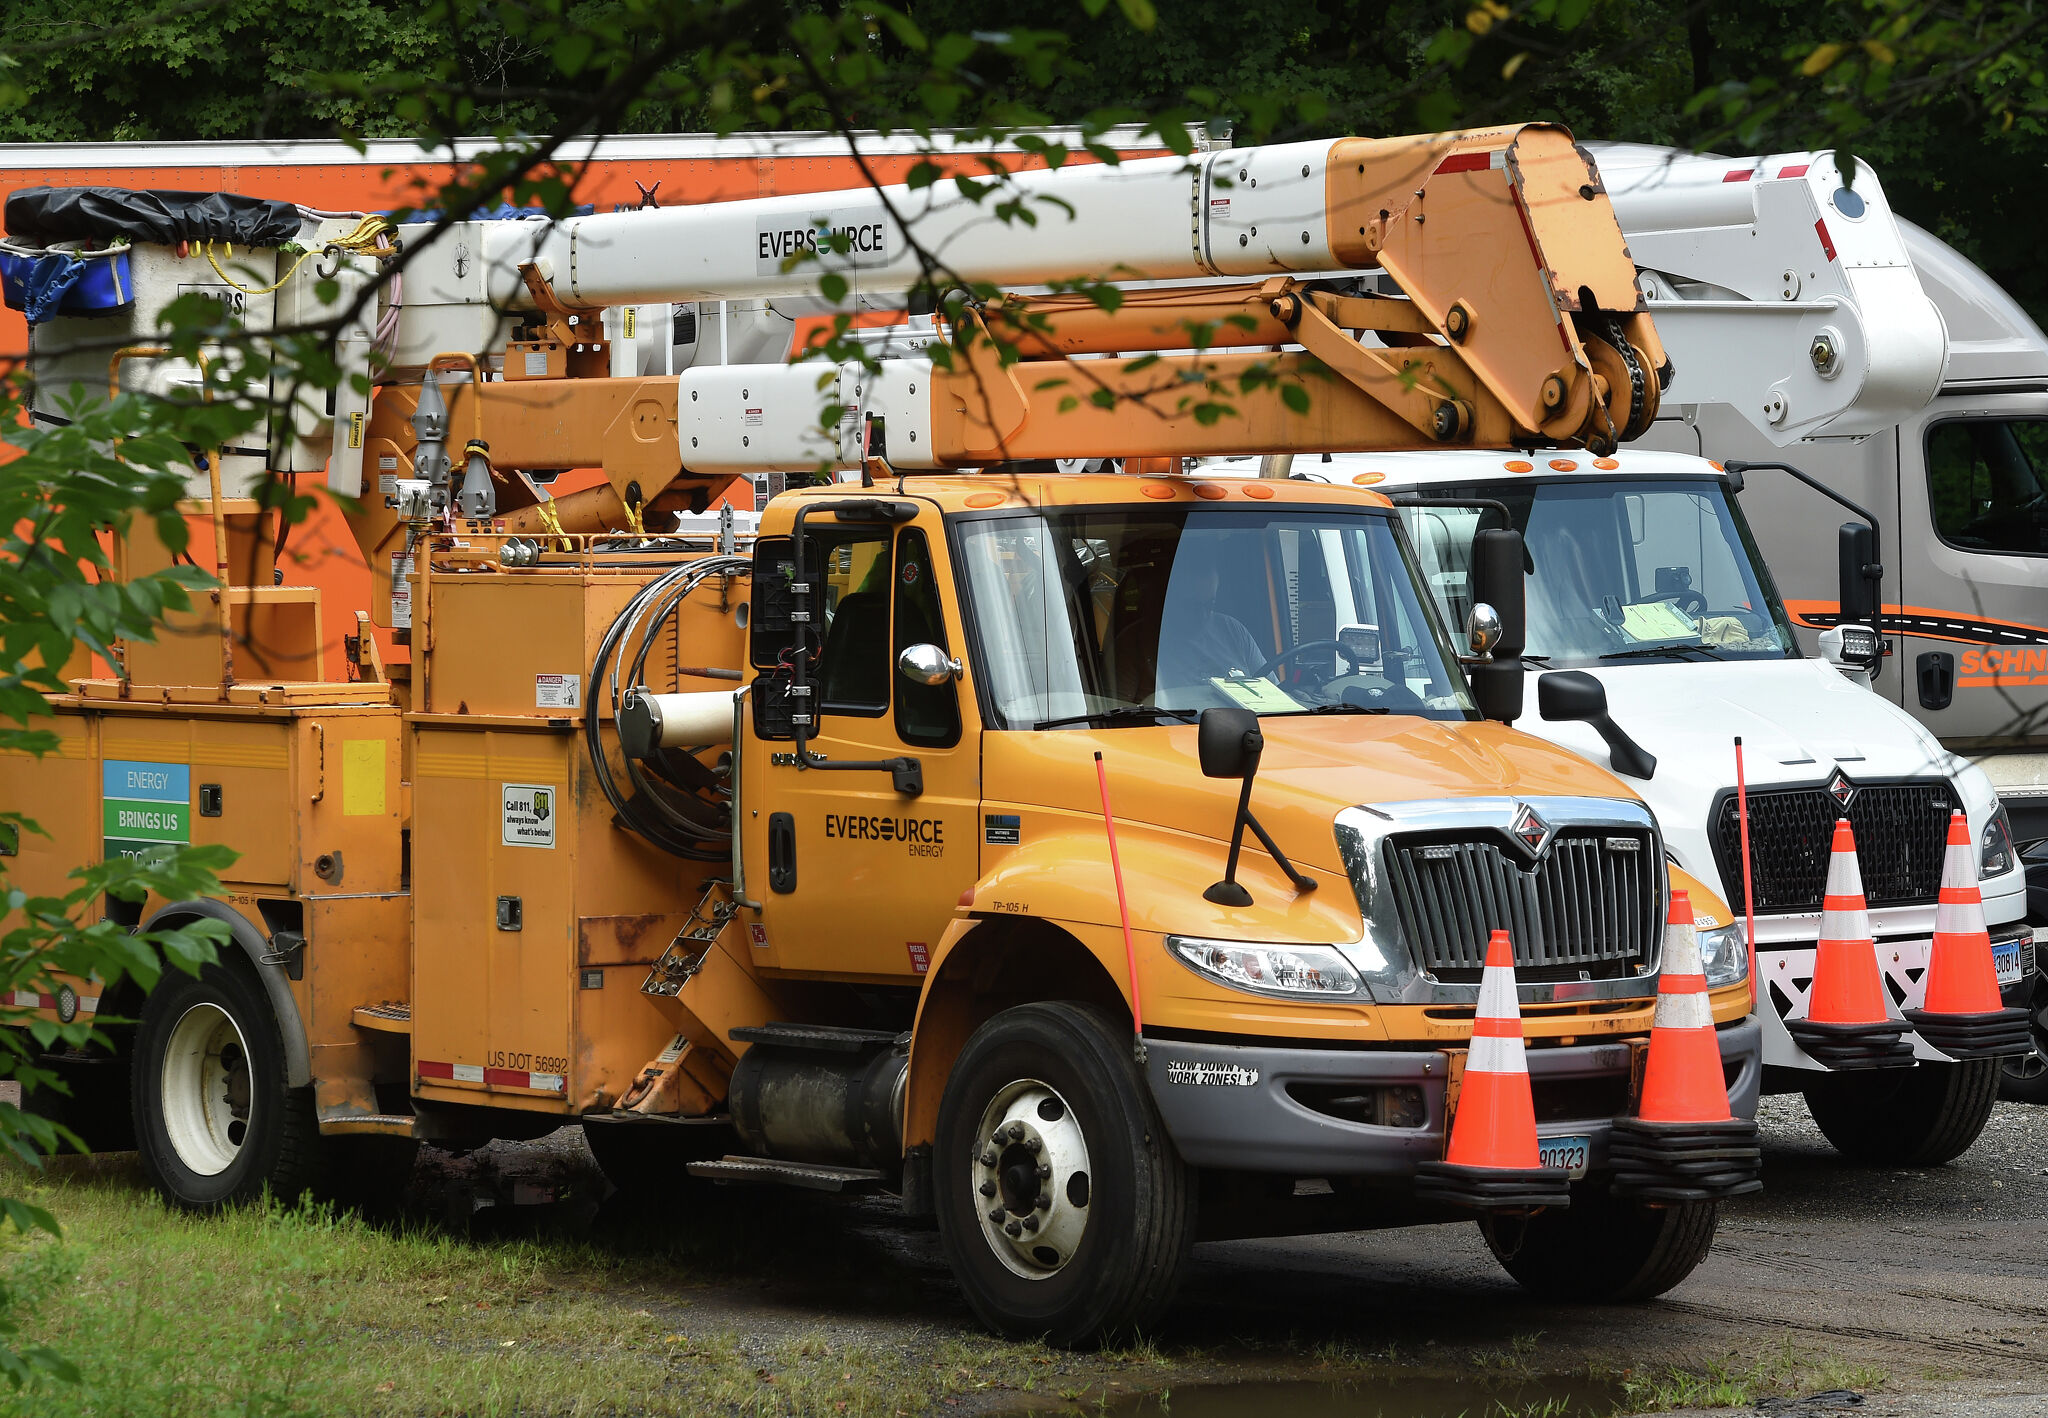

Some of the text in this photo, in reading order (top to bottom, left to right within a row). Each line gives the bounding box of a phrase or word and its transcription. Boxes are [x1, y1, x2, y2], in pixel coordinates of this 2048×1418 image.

[1960, 648, 2048, 674] SCHN
[541, 676, 562, 684] DANGER
[127, 771, 169, 790] ENERGY
[506, 800, 532, 813] Call 811,
[535, 793, 548, 810] 811
[119, 810, 178, 831] BRINGS US
[506, 816, 539, 825] always know
[517, 827, 551, 837] what's below!
[826, 814, 944, 843] EVERSOURCE
[909, 844, 944, 858] ENERGY
[992, 901, 1029, 913] TP-105 H
[910, 945, 927, 953] DIESEL
[914, 954, 927, 962] FUEL
[916, 963, 928, 972] ONLY
[487, 1051, 568, 1074] US DOT 56992
[1167, 1060, 1197, 1071] SLOW
[1200, 1062, 1234, 1072] DOWN
[1168, 1070, 1242, 1086] WORK ZONES!
[1539, 1147, 1584, 1169] 90323
